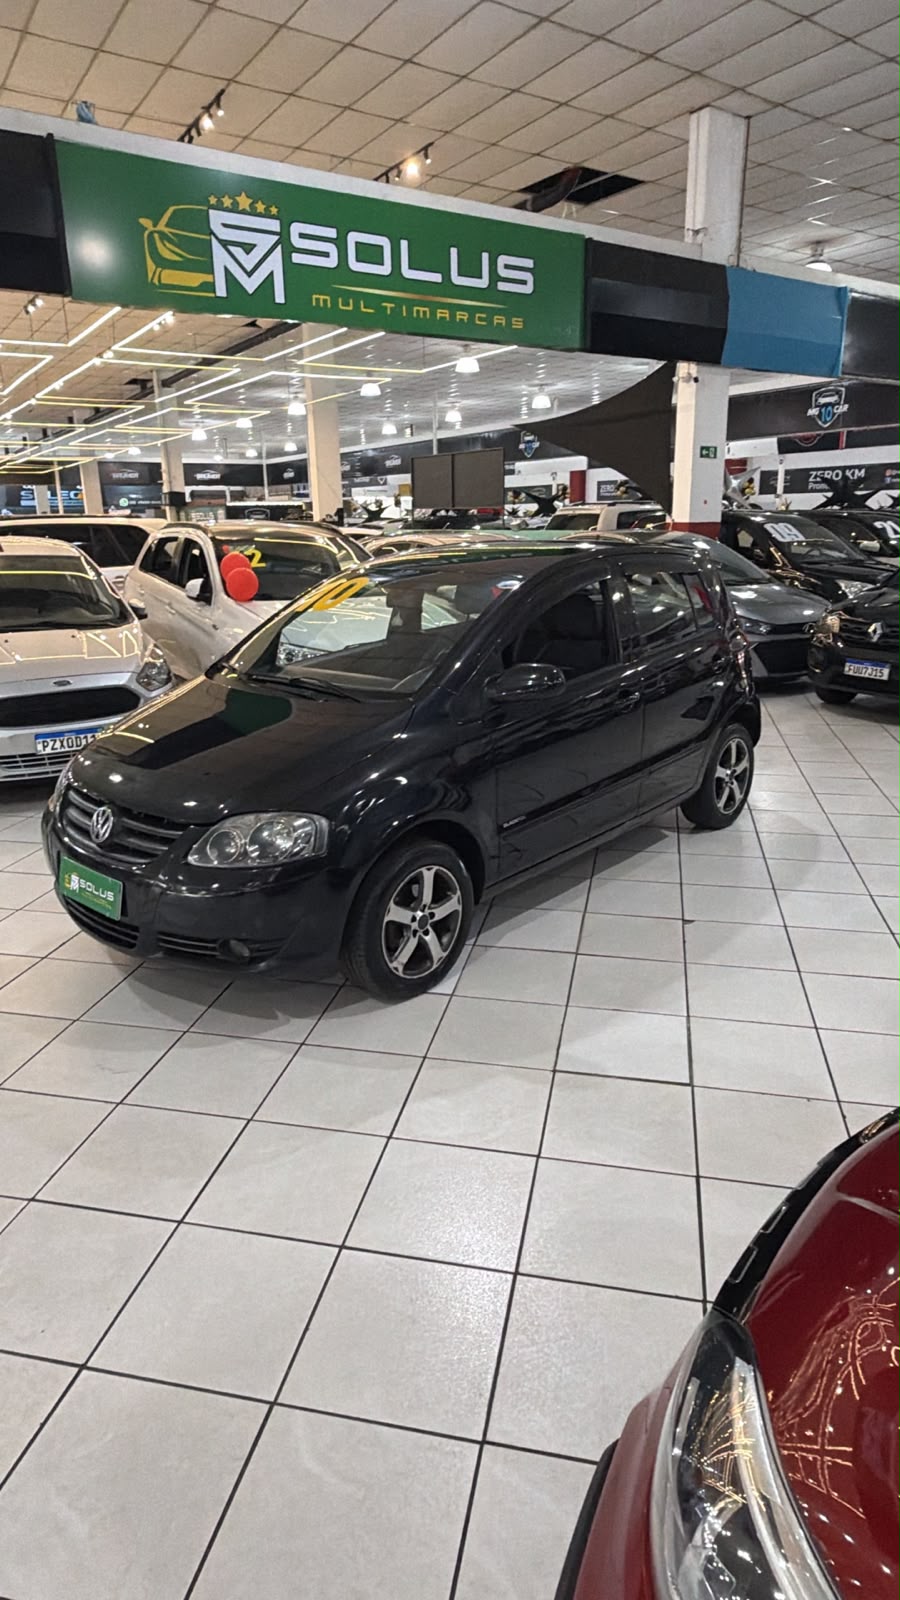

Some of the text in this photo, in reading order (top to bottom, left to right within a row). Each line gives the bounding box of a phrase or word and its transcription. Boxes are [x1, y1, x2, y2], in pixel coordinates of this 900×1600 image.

[289, 221, 535, 295] SOLUS
[311, 293, 525, 329] MULTIMARCAS
[820, 405, 833, 422] 10
[808, 468, 866, 482] ZERO KM
[80, 879, 115, 902] SOLUS
